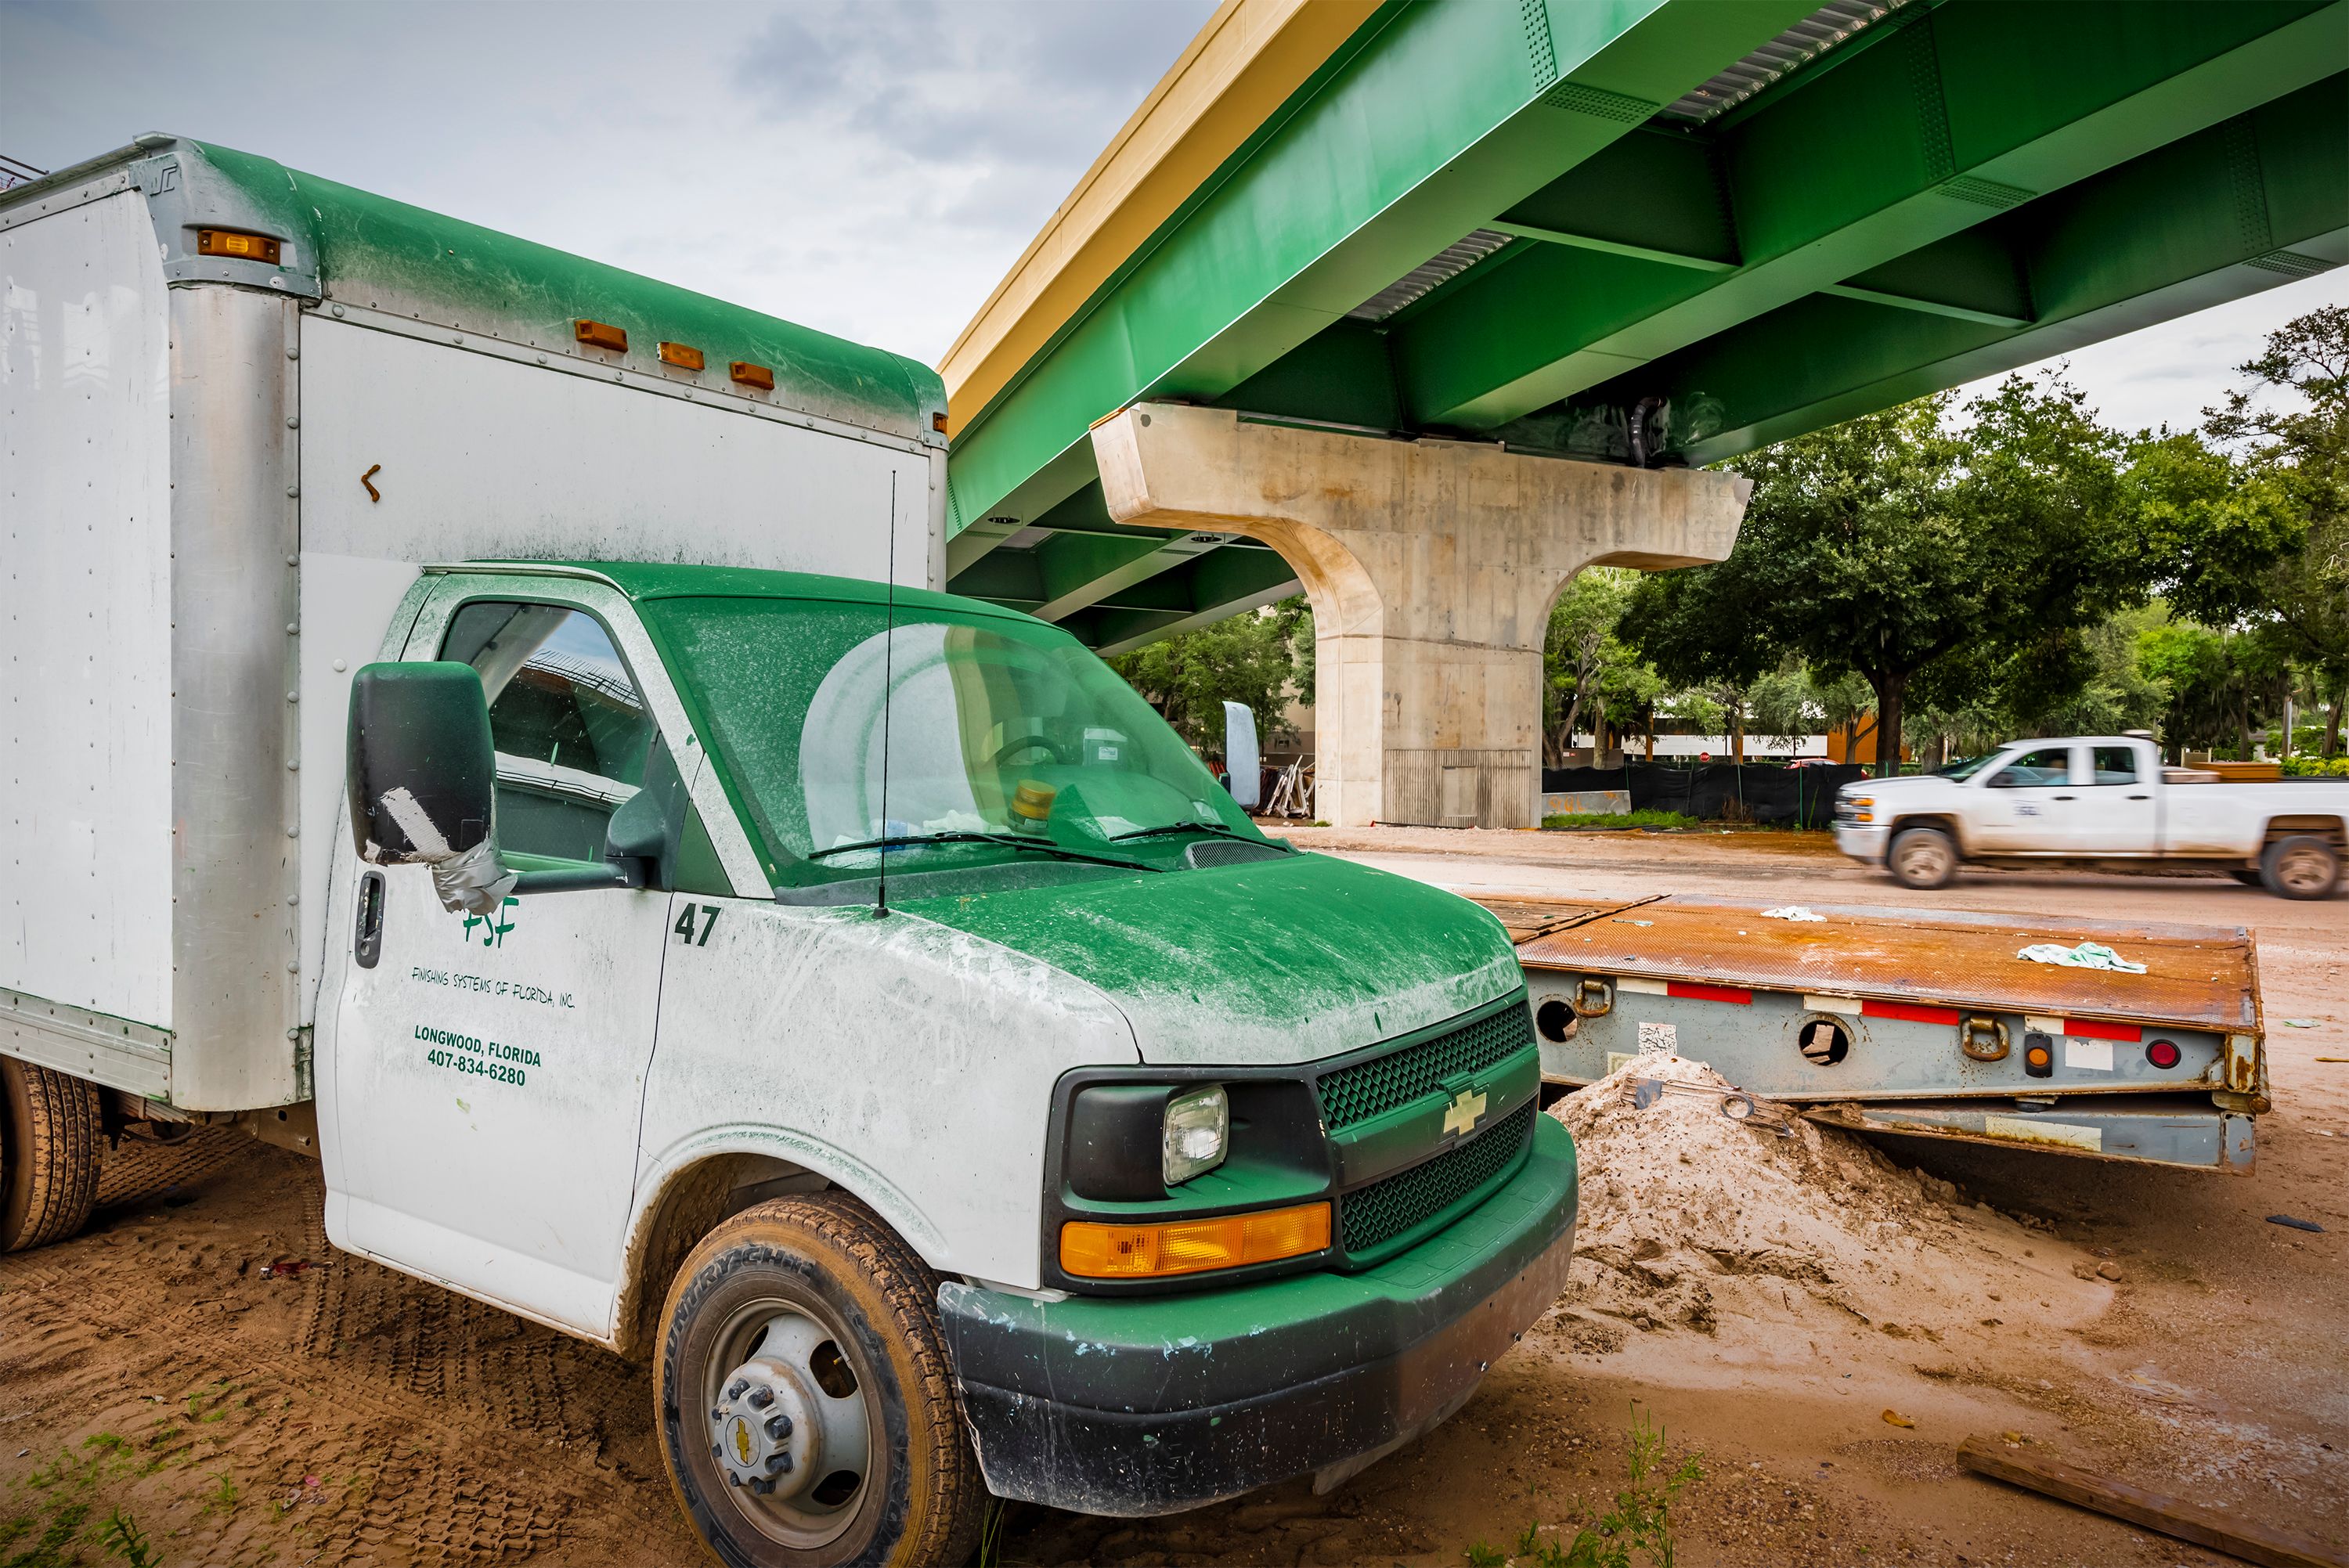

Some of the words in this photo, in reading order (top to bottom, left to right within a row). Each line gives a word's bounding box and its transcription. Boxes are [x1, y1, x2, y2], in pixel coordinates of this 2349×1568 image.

[674, 903, 722, 947] 47
[411, 967, 449, 986] FINISHING
[453, 973, 492, 993] SYSTEMS
[495, 981, 509, 996] OF
[512, 984, 555, 1008] FLORIDA,
[414, 1025, 485, 1058] LONGWOOD,
[488, 1042, 541, 1068] FLORIDA
[427, 1049, 526, 1087] 407-834-6280
